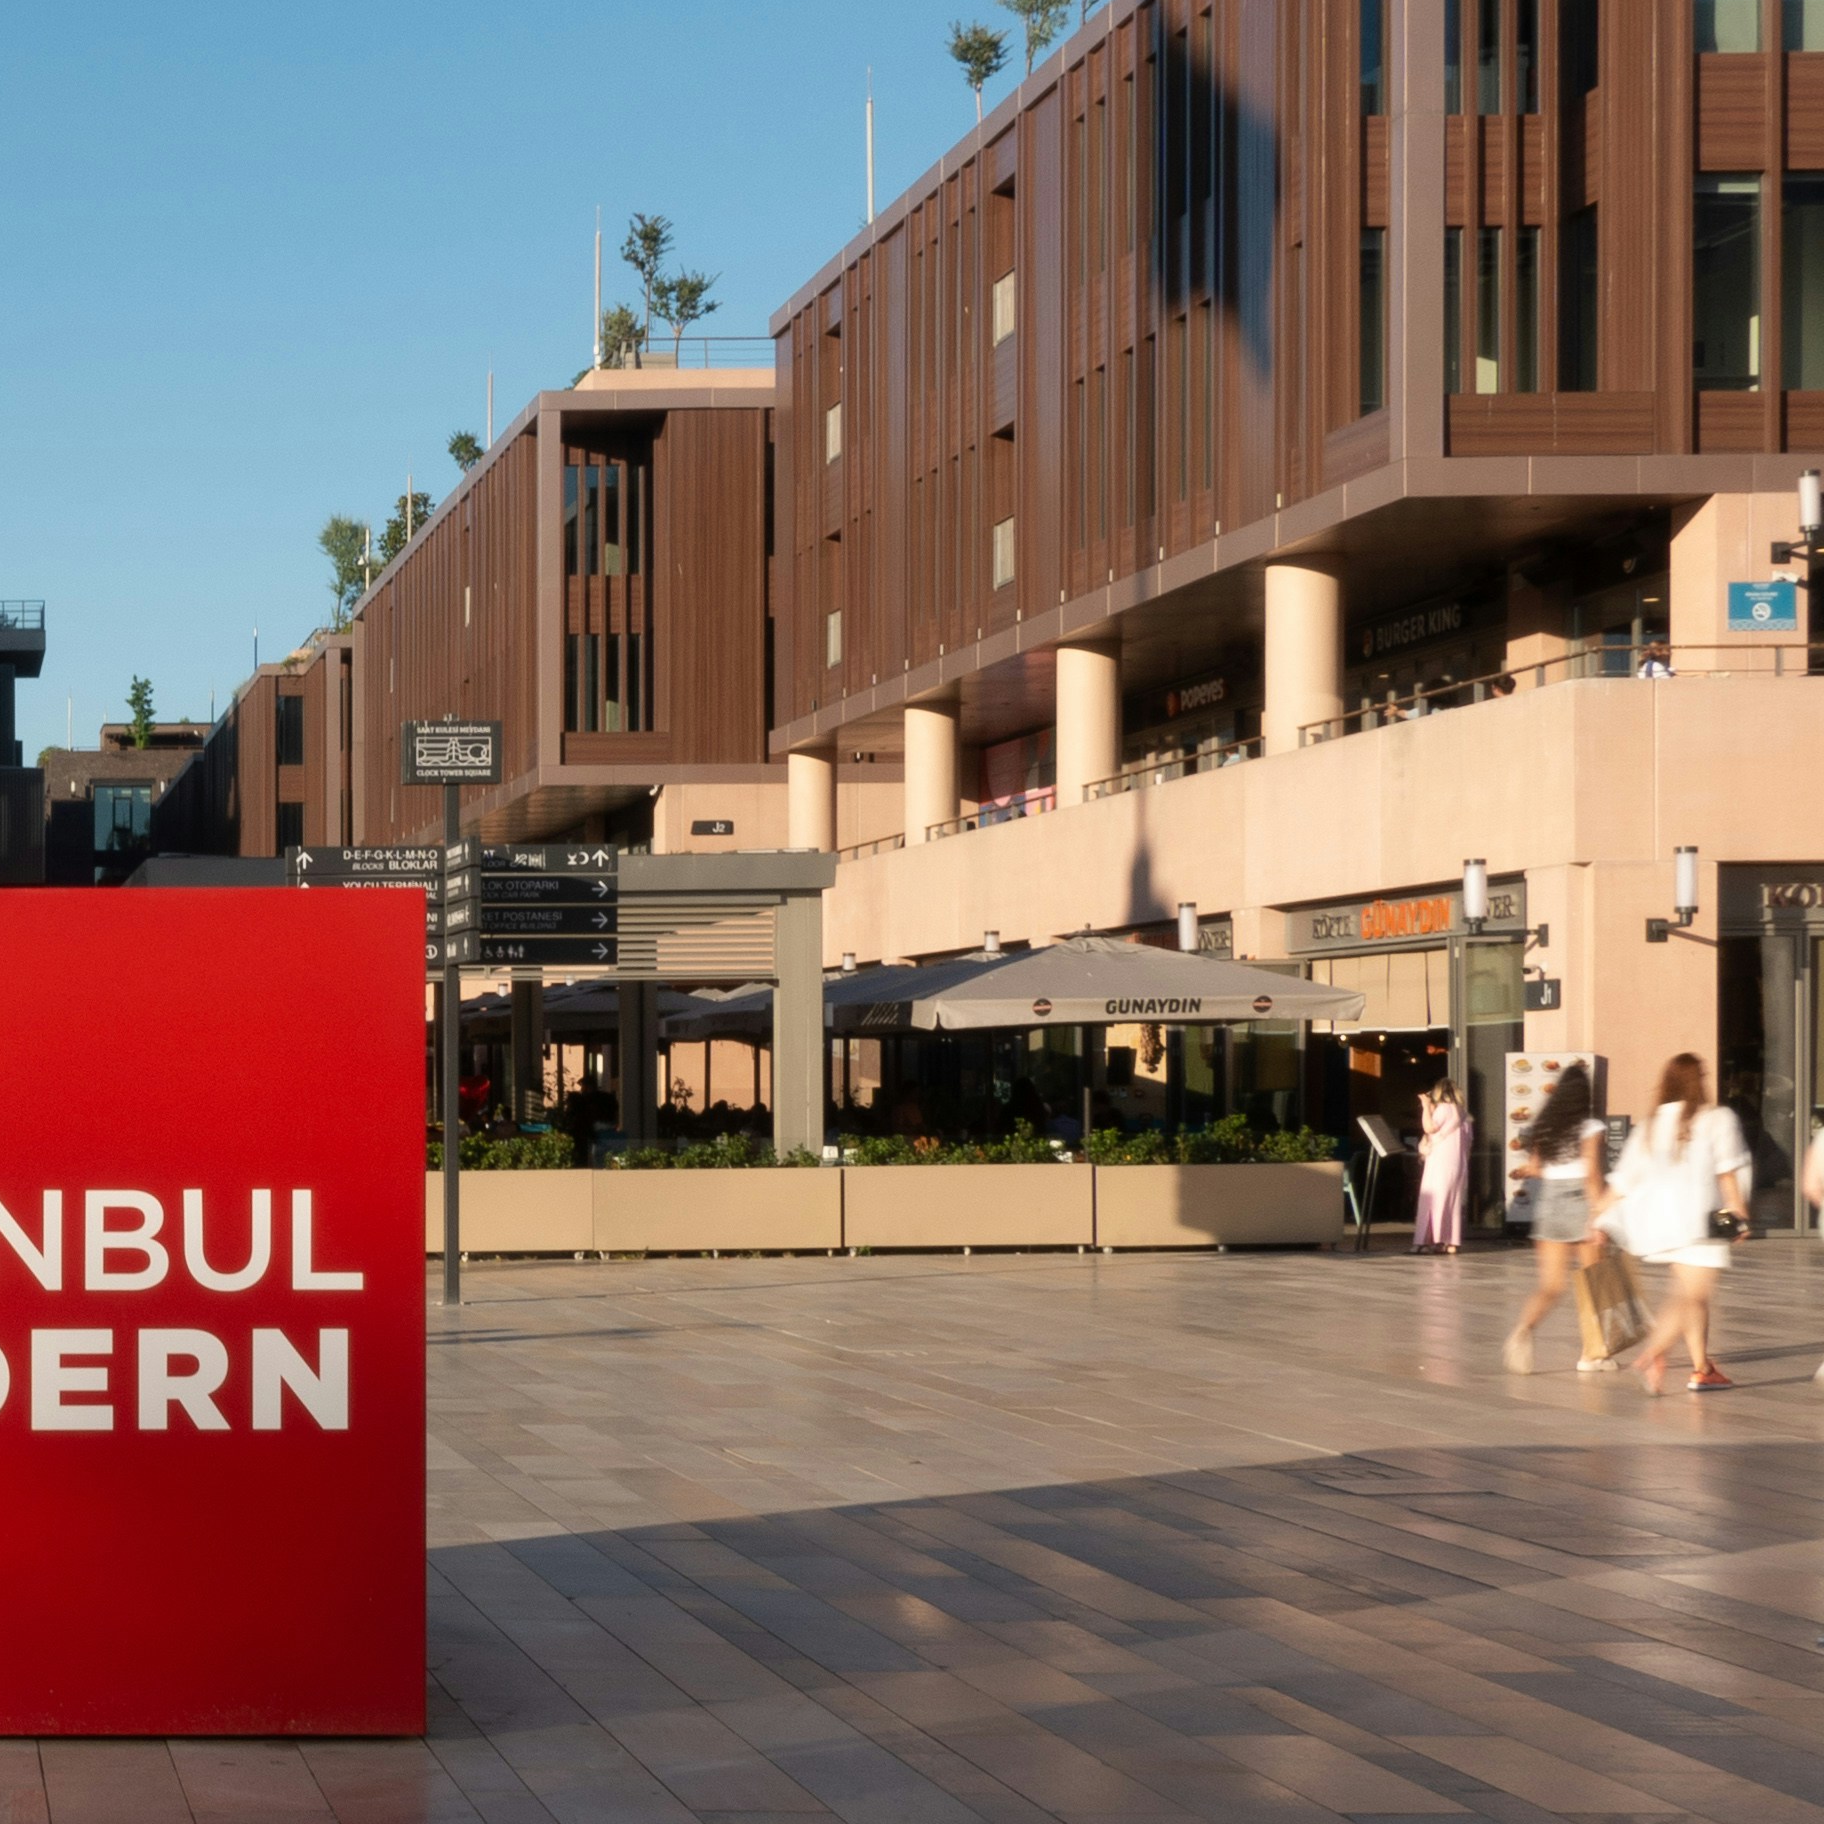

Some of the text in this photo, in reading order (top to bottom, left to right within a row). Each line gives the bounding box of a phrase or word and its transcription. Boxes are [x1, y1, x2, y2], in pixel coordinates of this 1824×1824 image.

[1377, 603, 1462, 651] BURGER KING
[416, 726, 434, 734] SAAT
[459, 726, 491, 734] MEYDANI
[416, 769, 492, 778] CLOCK TOWER SQUARE
[712, 821, 726, 833] J2
[351, 862, 385, 871] BLOCKS
[388, 860, 438, 870] BLOKLAR
[482, 880, 560, 891] LOK OTOPARKI
[1360, 896, 1452, 940] GÜNAYDIN
[1540, 982, 1553, 1005] J1
